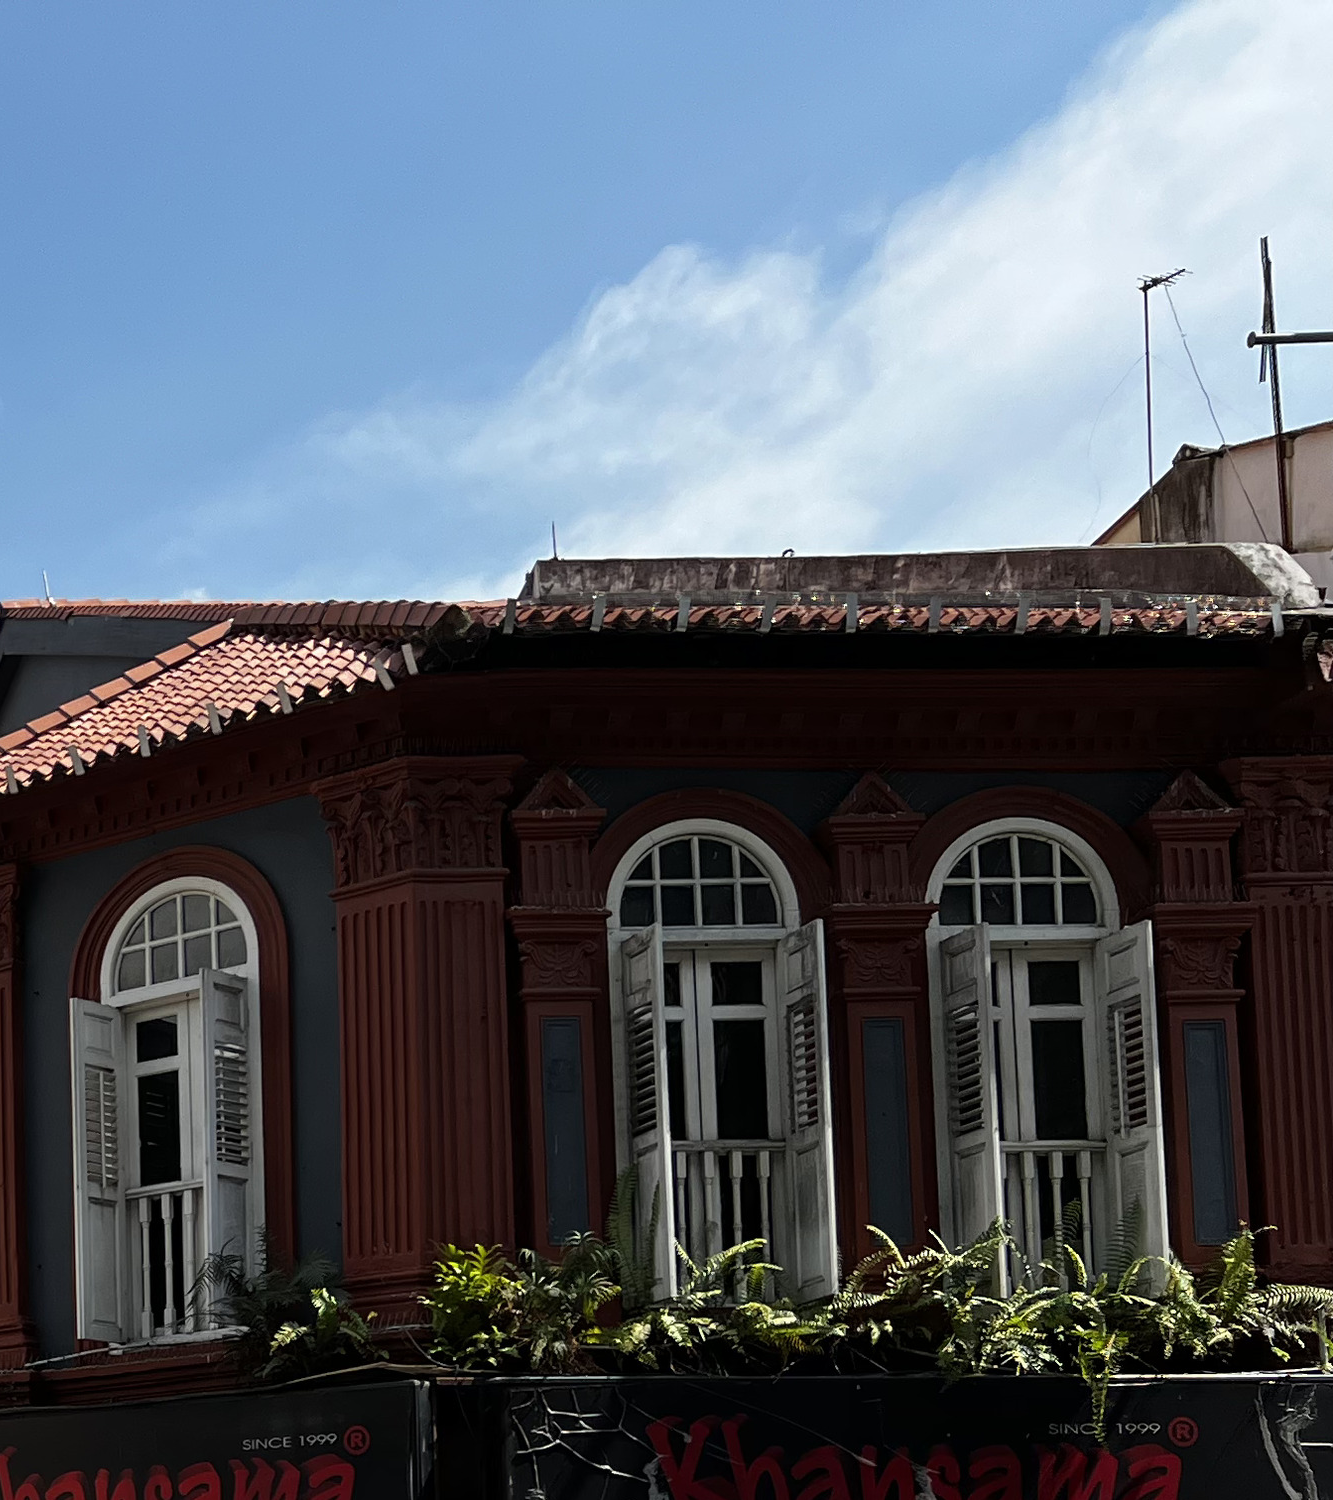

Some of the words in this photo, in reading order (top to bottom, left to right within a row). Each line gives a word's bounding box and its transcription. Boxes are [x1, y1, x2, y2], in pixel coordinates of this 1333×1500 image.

[1115, 1422, 1161, 1436] 1999
[242, 1436, 292, 1451] SINCE
[298, 1432, 338, 1448] 1999
